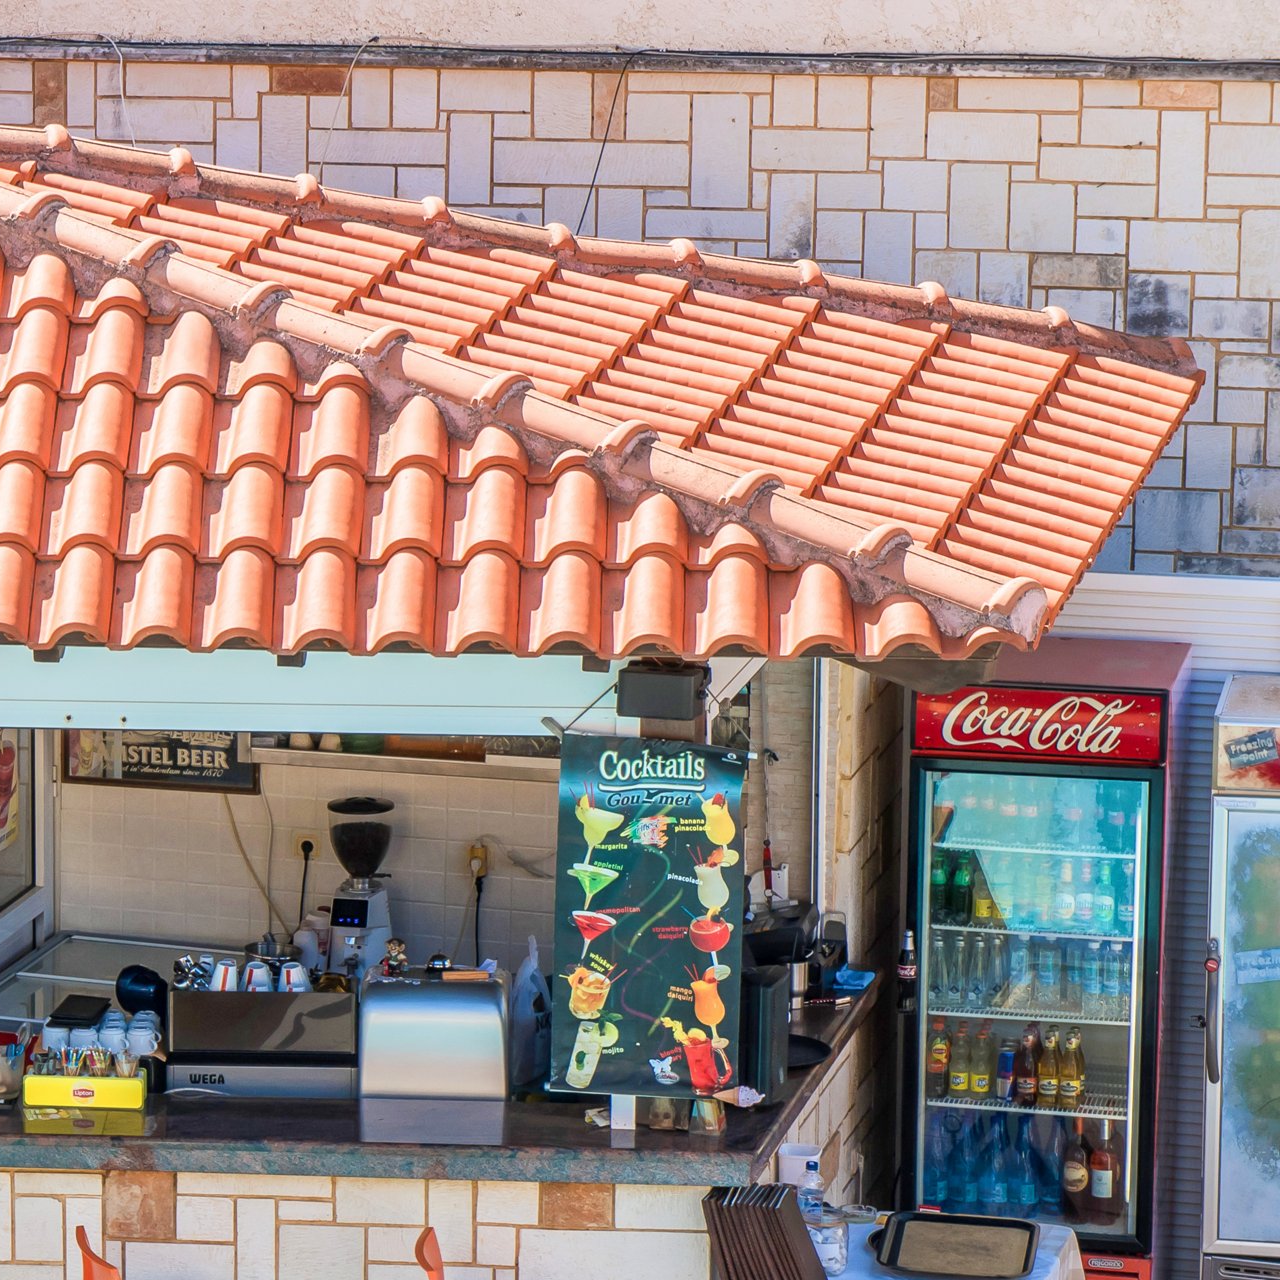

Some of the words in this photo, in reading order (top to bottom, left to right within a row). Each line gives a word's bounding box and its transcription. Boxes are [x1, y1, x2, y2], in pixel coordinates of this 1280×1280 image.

[942, 690, 1136, 754] Coca-Cola
[1230, 736, 1274, 754] Freezing
[176, 748, 230, 770] BEER
[1241, 749, 1269, 763] Point
[598, 749, 706, 781] Cocktails
[201, 768, 224, 777] 1870
[594, 843, 628, 851] margarita
[593, 860, 624, 872] appletini
[651, 925, 689, 934] strawberry
[589, 952, 614, 971] whiskey
[590, 961, 606, 974] sour
[669, 985, 693, 995] mango
[667, 991, 694, 1002] daiquiri
[601, 1047, 625, 1056] mojito
[189, 1073, 225, 1085] WEGA
[74, 1089, 93, 1098] Lipton
